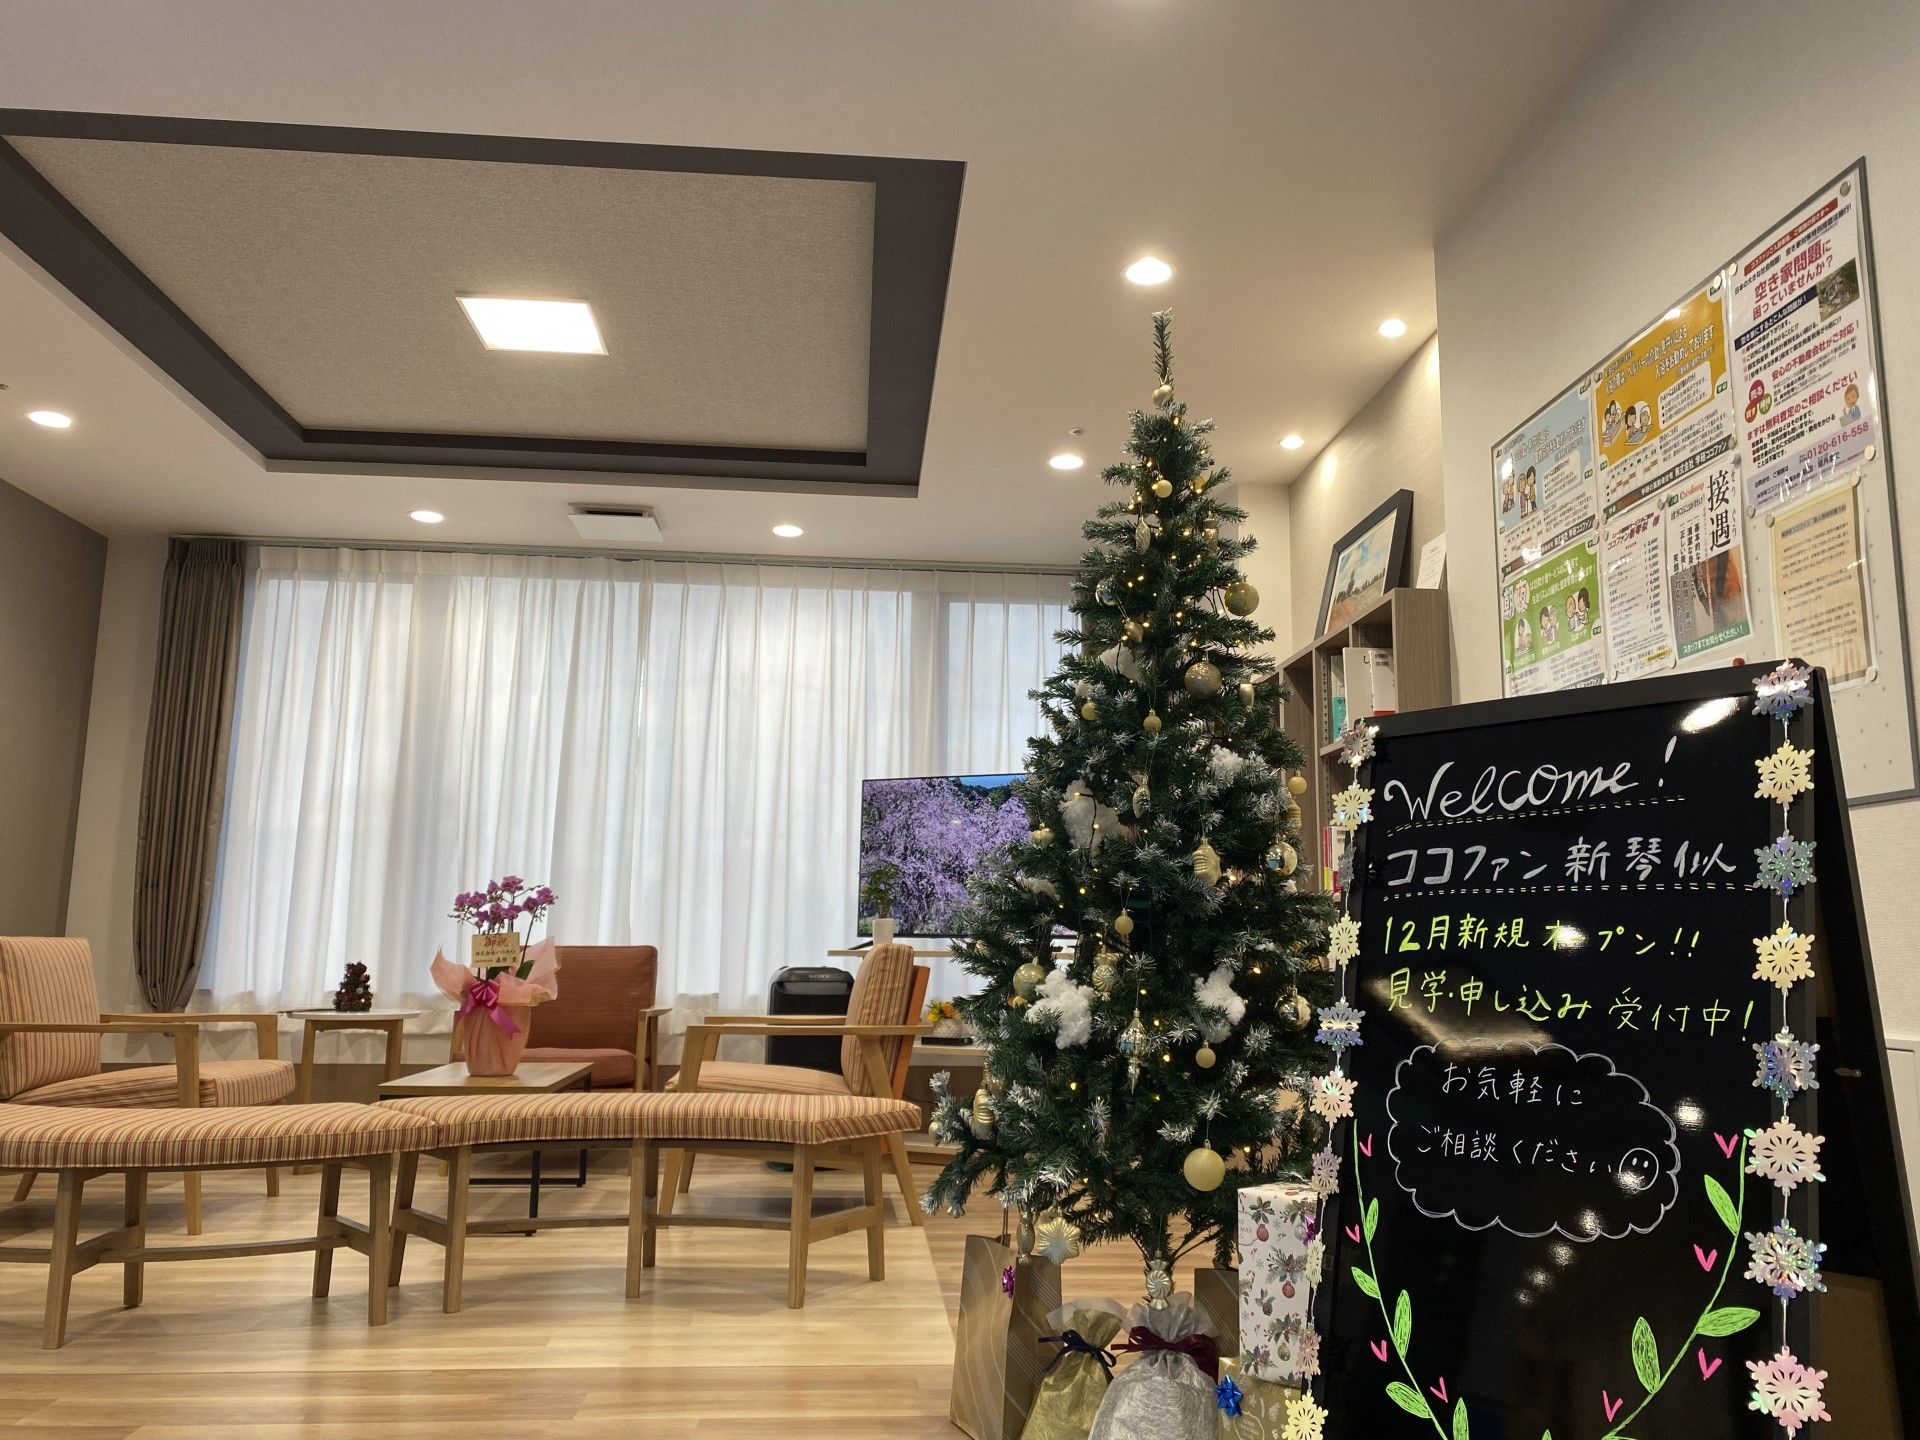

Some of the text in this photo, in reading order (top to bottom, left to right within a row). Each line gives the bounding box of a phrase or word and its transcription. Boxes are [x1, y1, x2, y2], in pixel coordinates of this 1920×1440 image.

[1753, 255, 1833, 321] 困っていませんか？
[1755, 239, 1831, 304] 空き家問題に
[1807, 422, 1869, 460] 0120-616-558
[1707, 470, 1732, 552] 接遇
[1384, 736, 1677, 820] Welcome!
[1385, 913, 1700, 958] 12月新規オプン!!
[1442, 1062, 1584, 1106] お気軽に
[1417, 1124, 1611, 1173] ご相談ください
